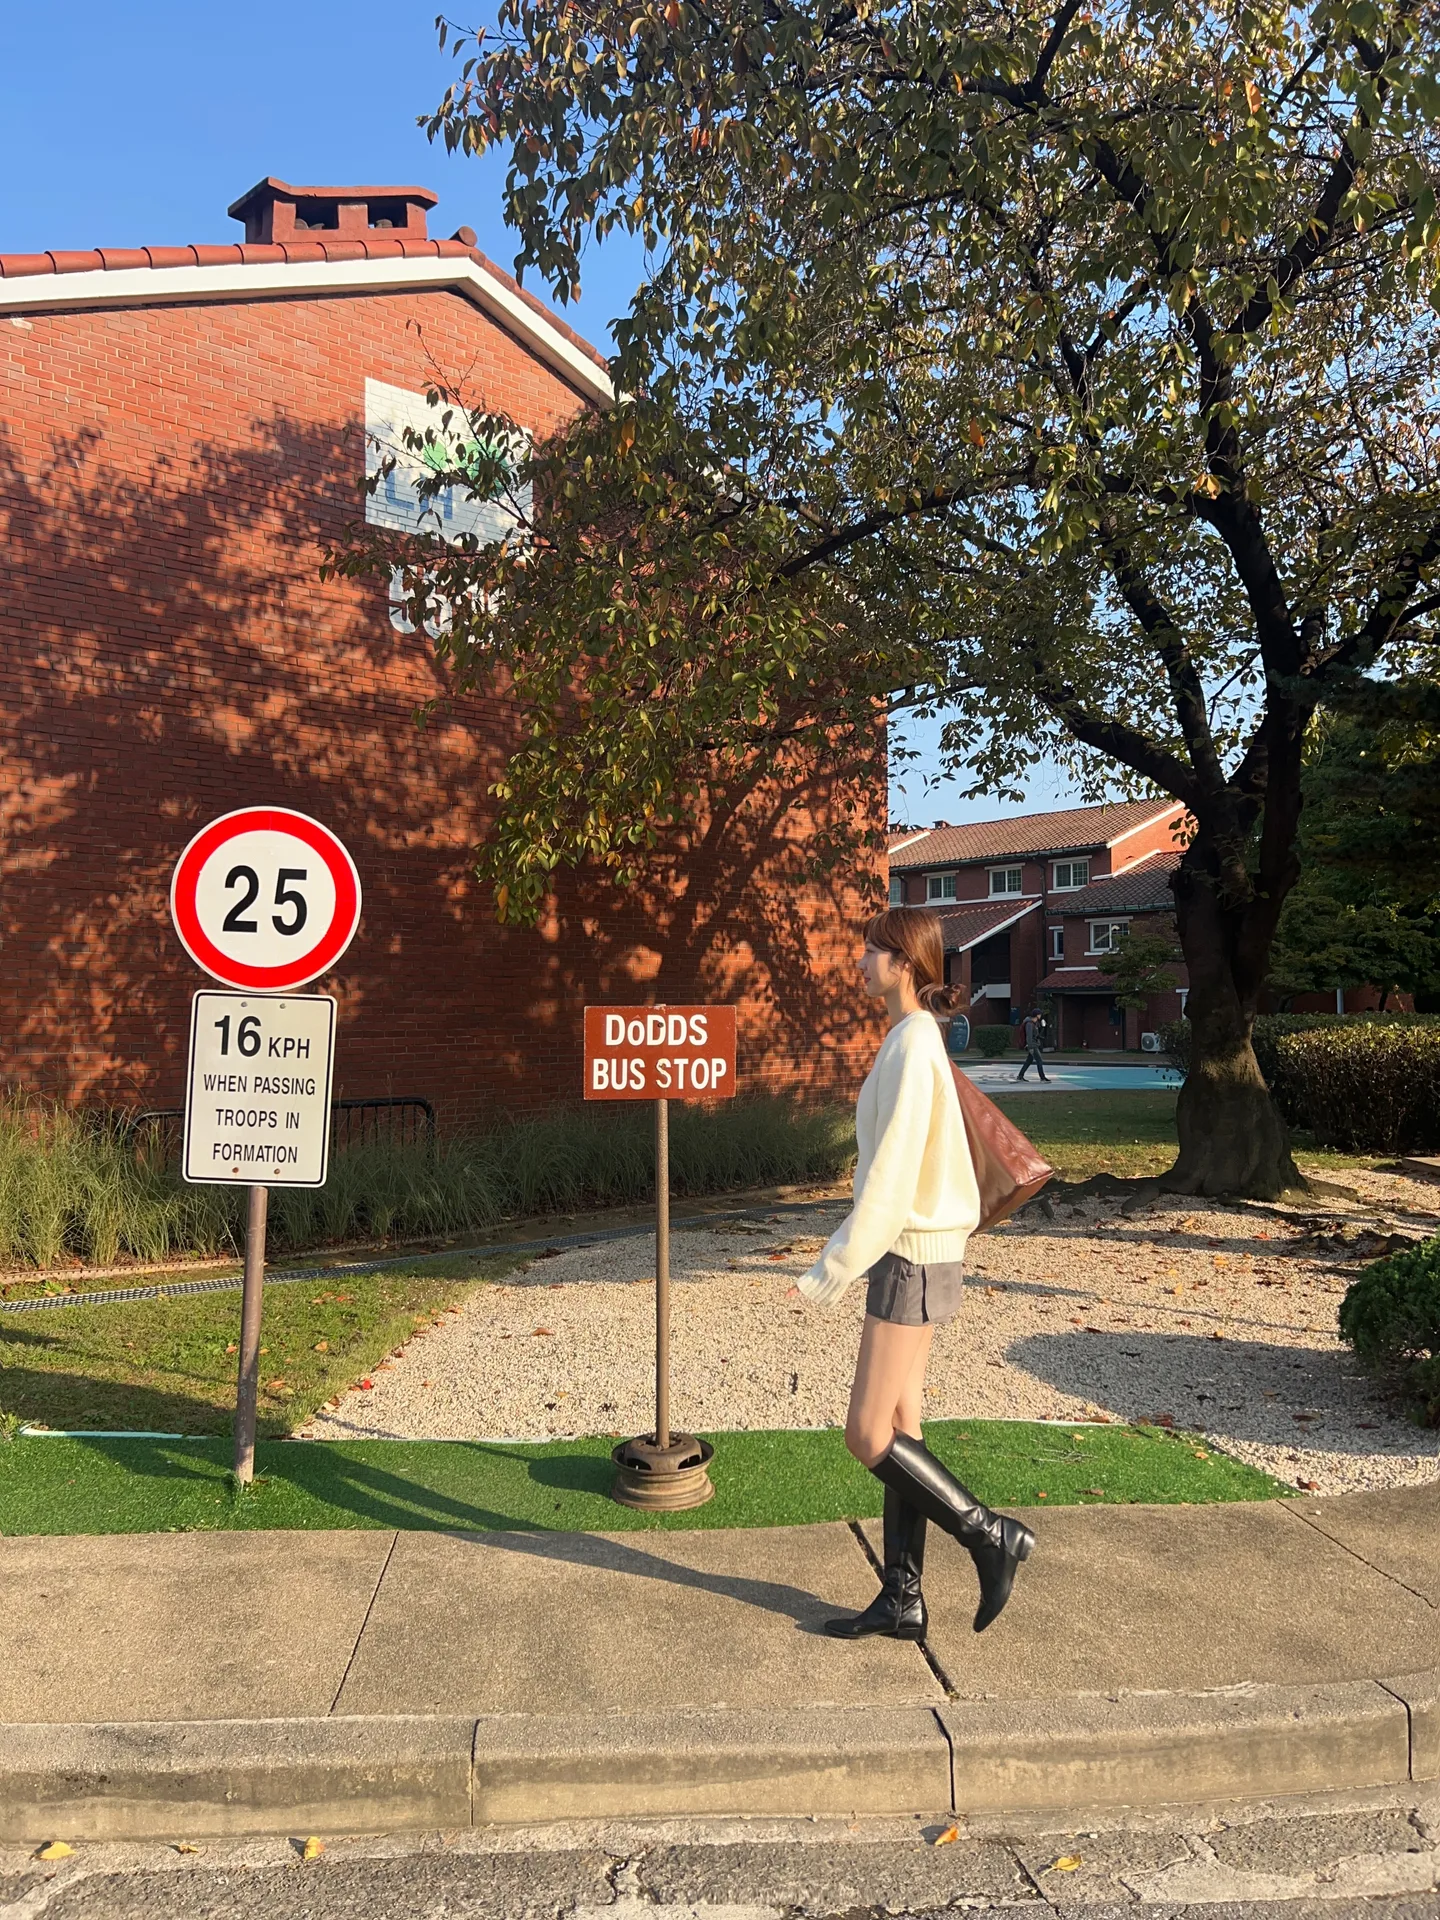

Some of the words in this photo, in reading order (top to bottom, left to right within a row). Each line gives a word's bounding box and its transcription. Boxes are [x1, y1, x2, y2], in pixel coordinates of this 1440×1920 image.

[222, 864, 308, 936] 25
[214, 1015, 262, 1058] 16
[268, 1037, 311, 1059] KPH
[605, 1014, 708, 1046] DoDDS
[203, 1073, 248, 1093] WHEN
[253, 1076, 316, 1096] PASSING
[592, 1058, 646, 1090] BUS
[656, 1058, 727, 1090] STOP
[215, 1108, 278, 1129] TROOPS
[285, 1111, 300, 1130] IN
[212, 1142, 298, 1164] FORMATION
